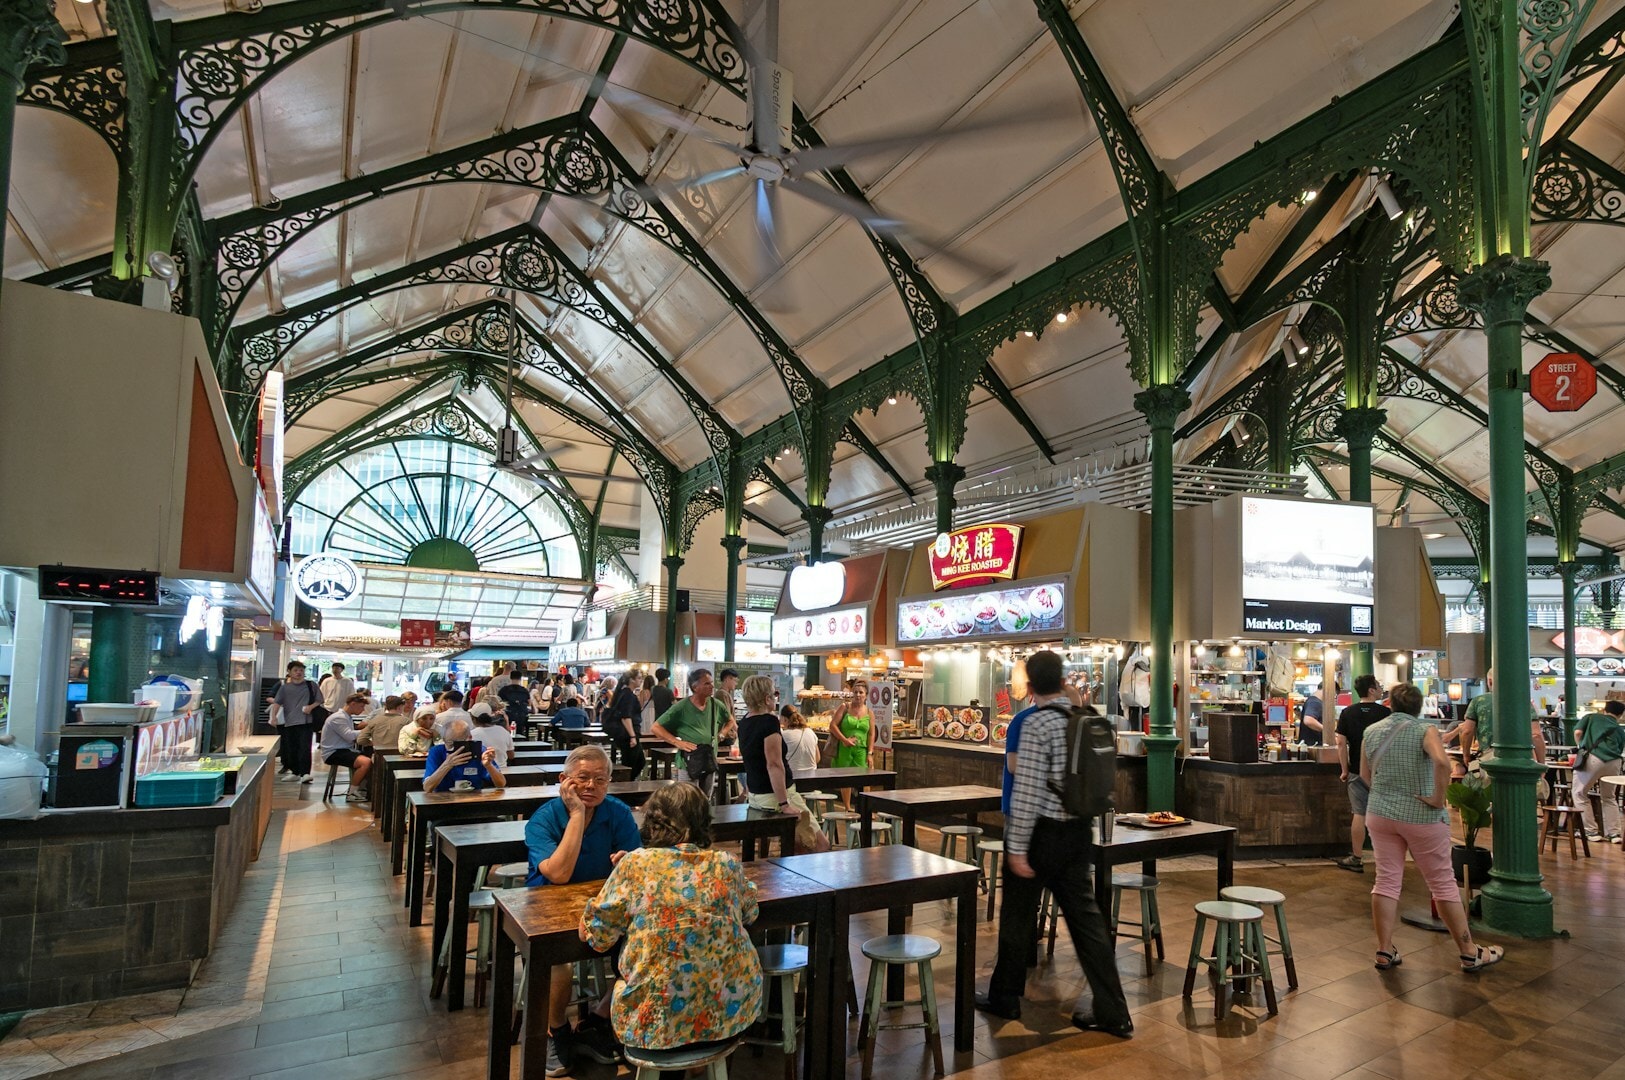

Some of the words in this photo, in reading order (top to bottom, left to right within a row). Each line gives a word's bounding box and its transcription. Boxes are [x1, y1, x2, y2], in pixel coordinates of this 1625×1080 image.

[1548, 363, 1577, 373] STREET
[1555, 375, 1571, 401] 2
[957, 562, 971, 573] KEE
[971, 557, 1003, 571] ROASTED
[1245, 617, 1285, 630] Market
[1285, 618, 1322, 634] Design
